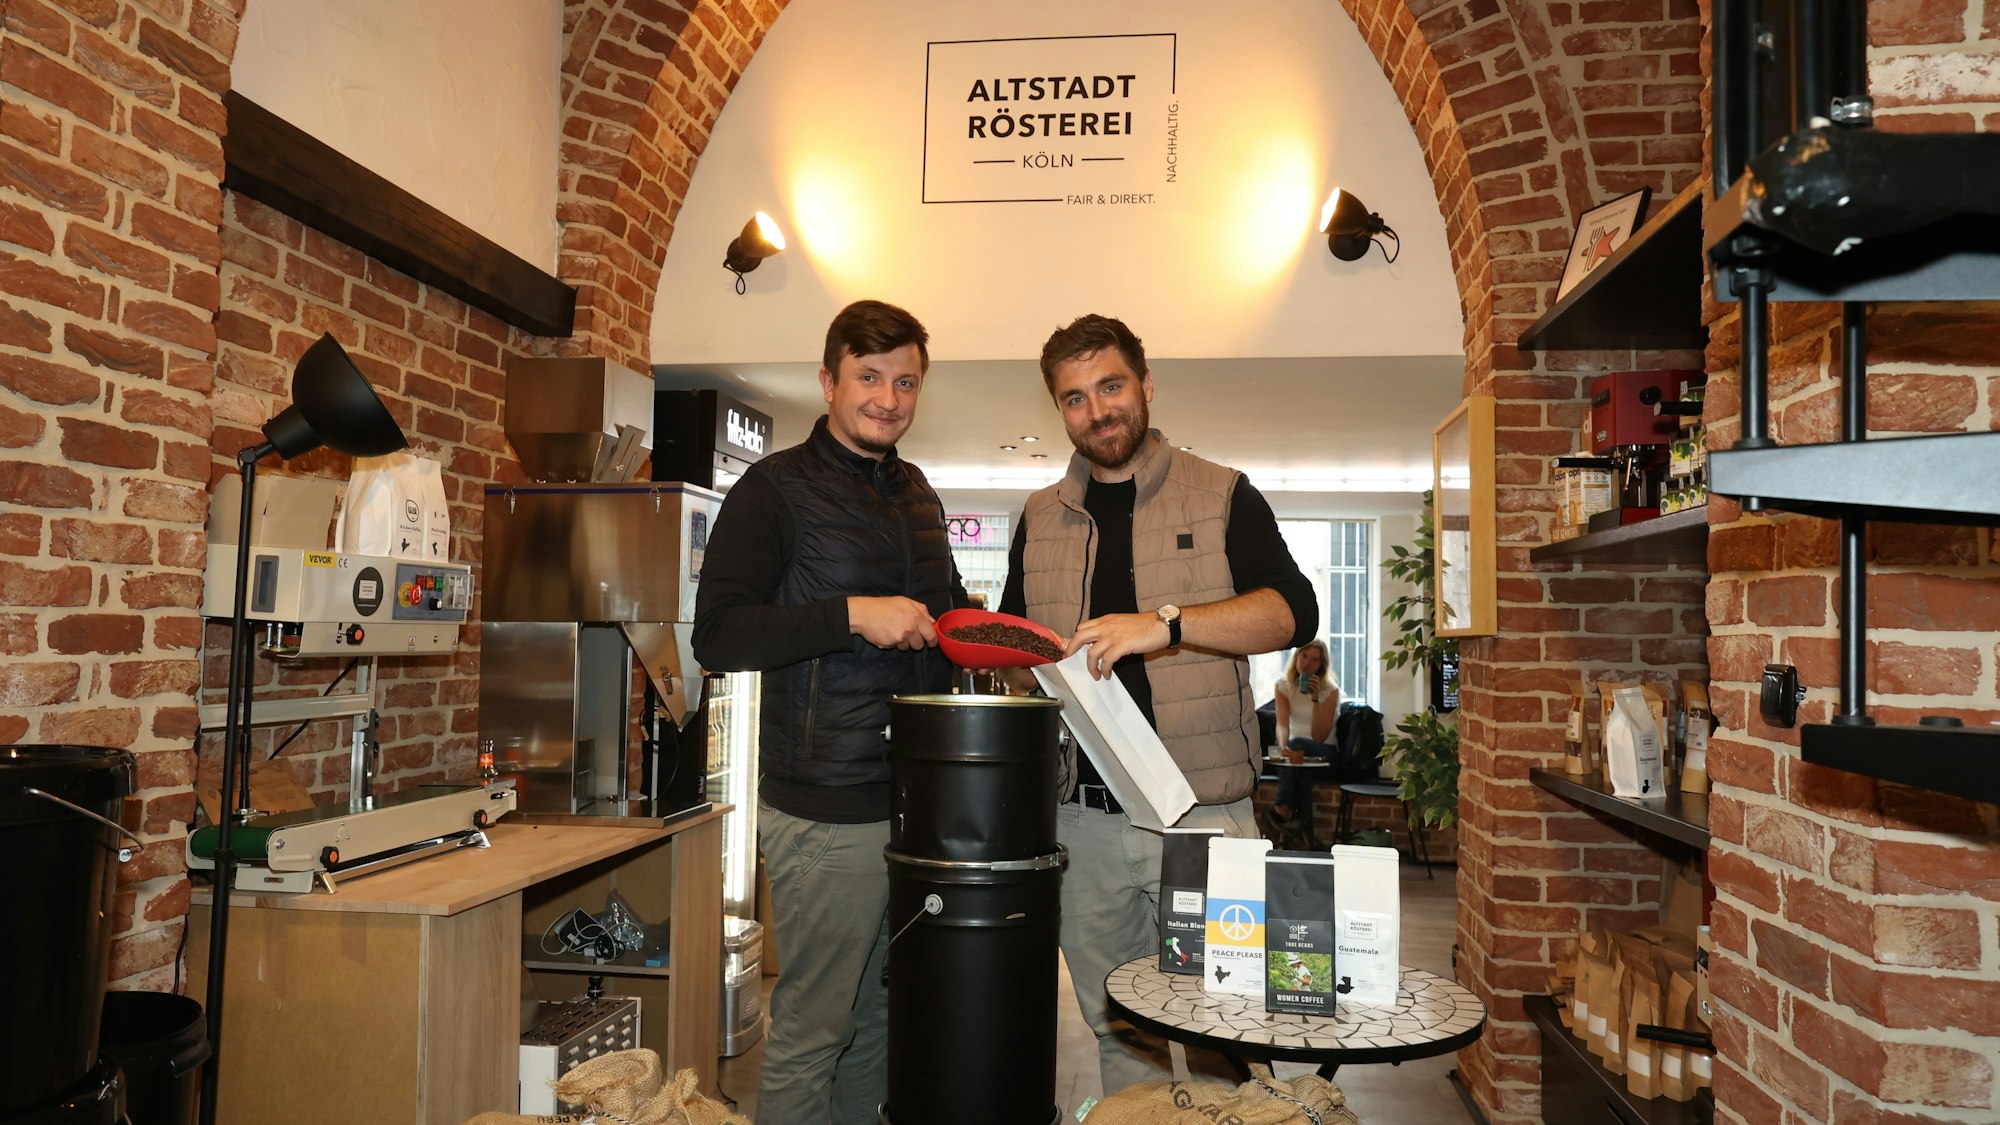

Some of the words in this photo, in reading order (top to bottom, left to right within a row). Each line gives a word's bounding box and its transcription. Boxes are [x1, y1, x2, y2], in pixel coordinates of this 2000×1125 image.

[967, 74, 1136, 102] ALTSTADT
[968, 107, 1132, 139] RÖSTEREI
[1166, 99, 1179, 183] NACHHALTIG.
[1023, 151, 1074, 169] KÖLN
[1066, 194, 1093, 205] FAIR
[1097, 194, 1106, 205] &
[1110, 193, 1156, 205] DIREKT.
[309, 555, 332, 564] VEVOR
[1167, 920, 1189, 928] Italian
[1211, 949, 1235, 957] PEACE
[1236, 950, 1263, 959] PLEASE
[1338, 945, 1379, 955] Guatemala
[1276, 993, 1300, 1003] WOMEN
[1300, 995, 1325, 1004] COFFEE
